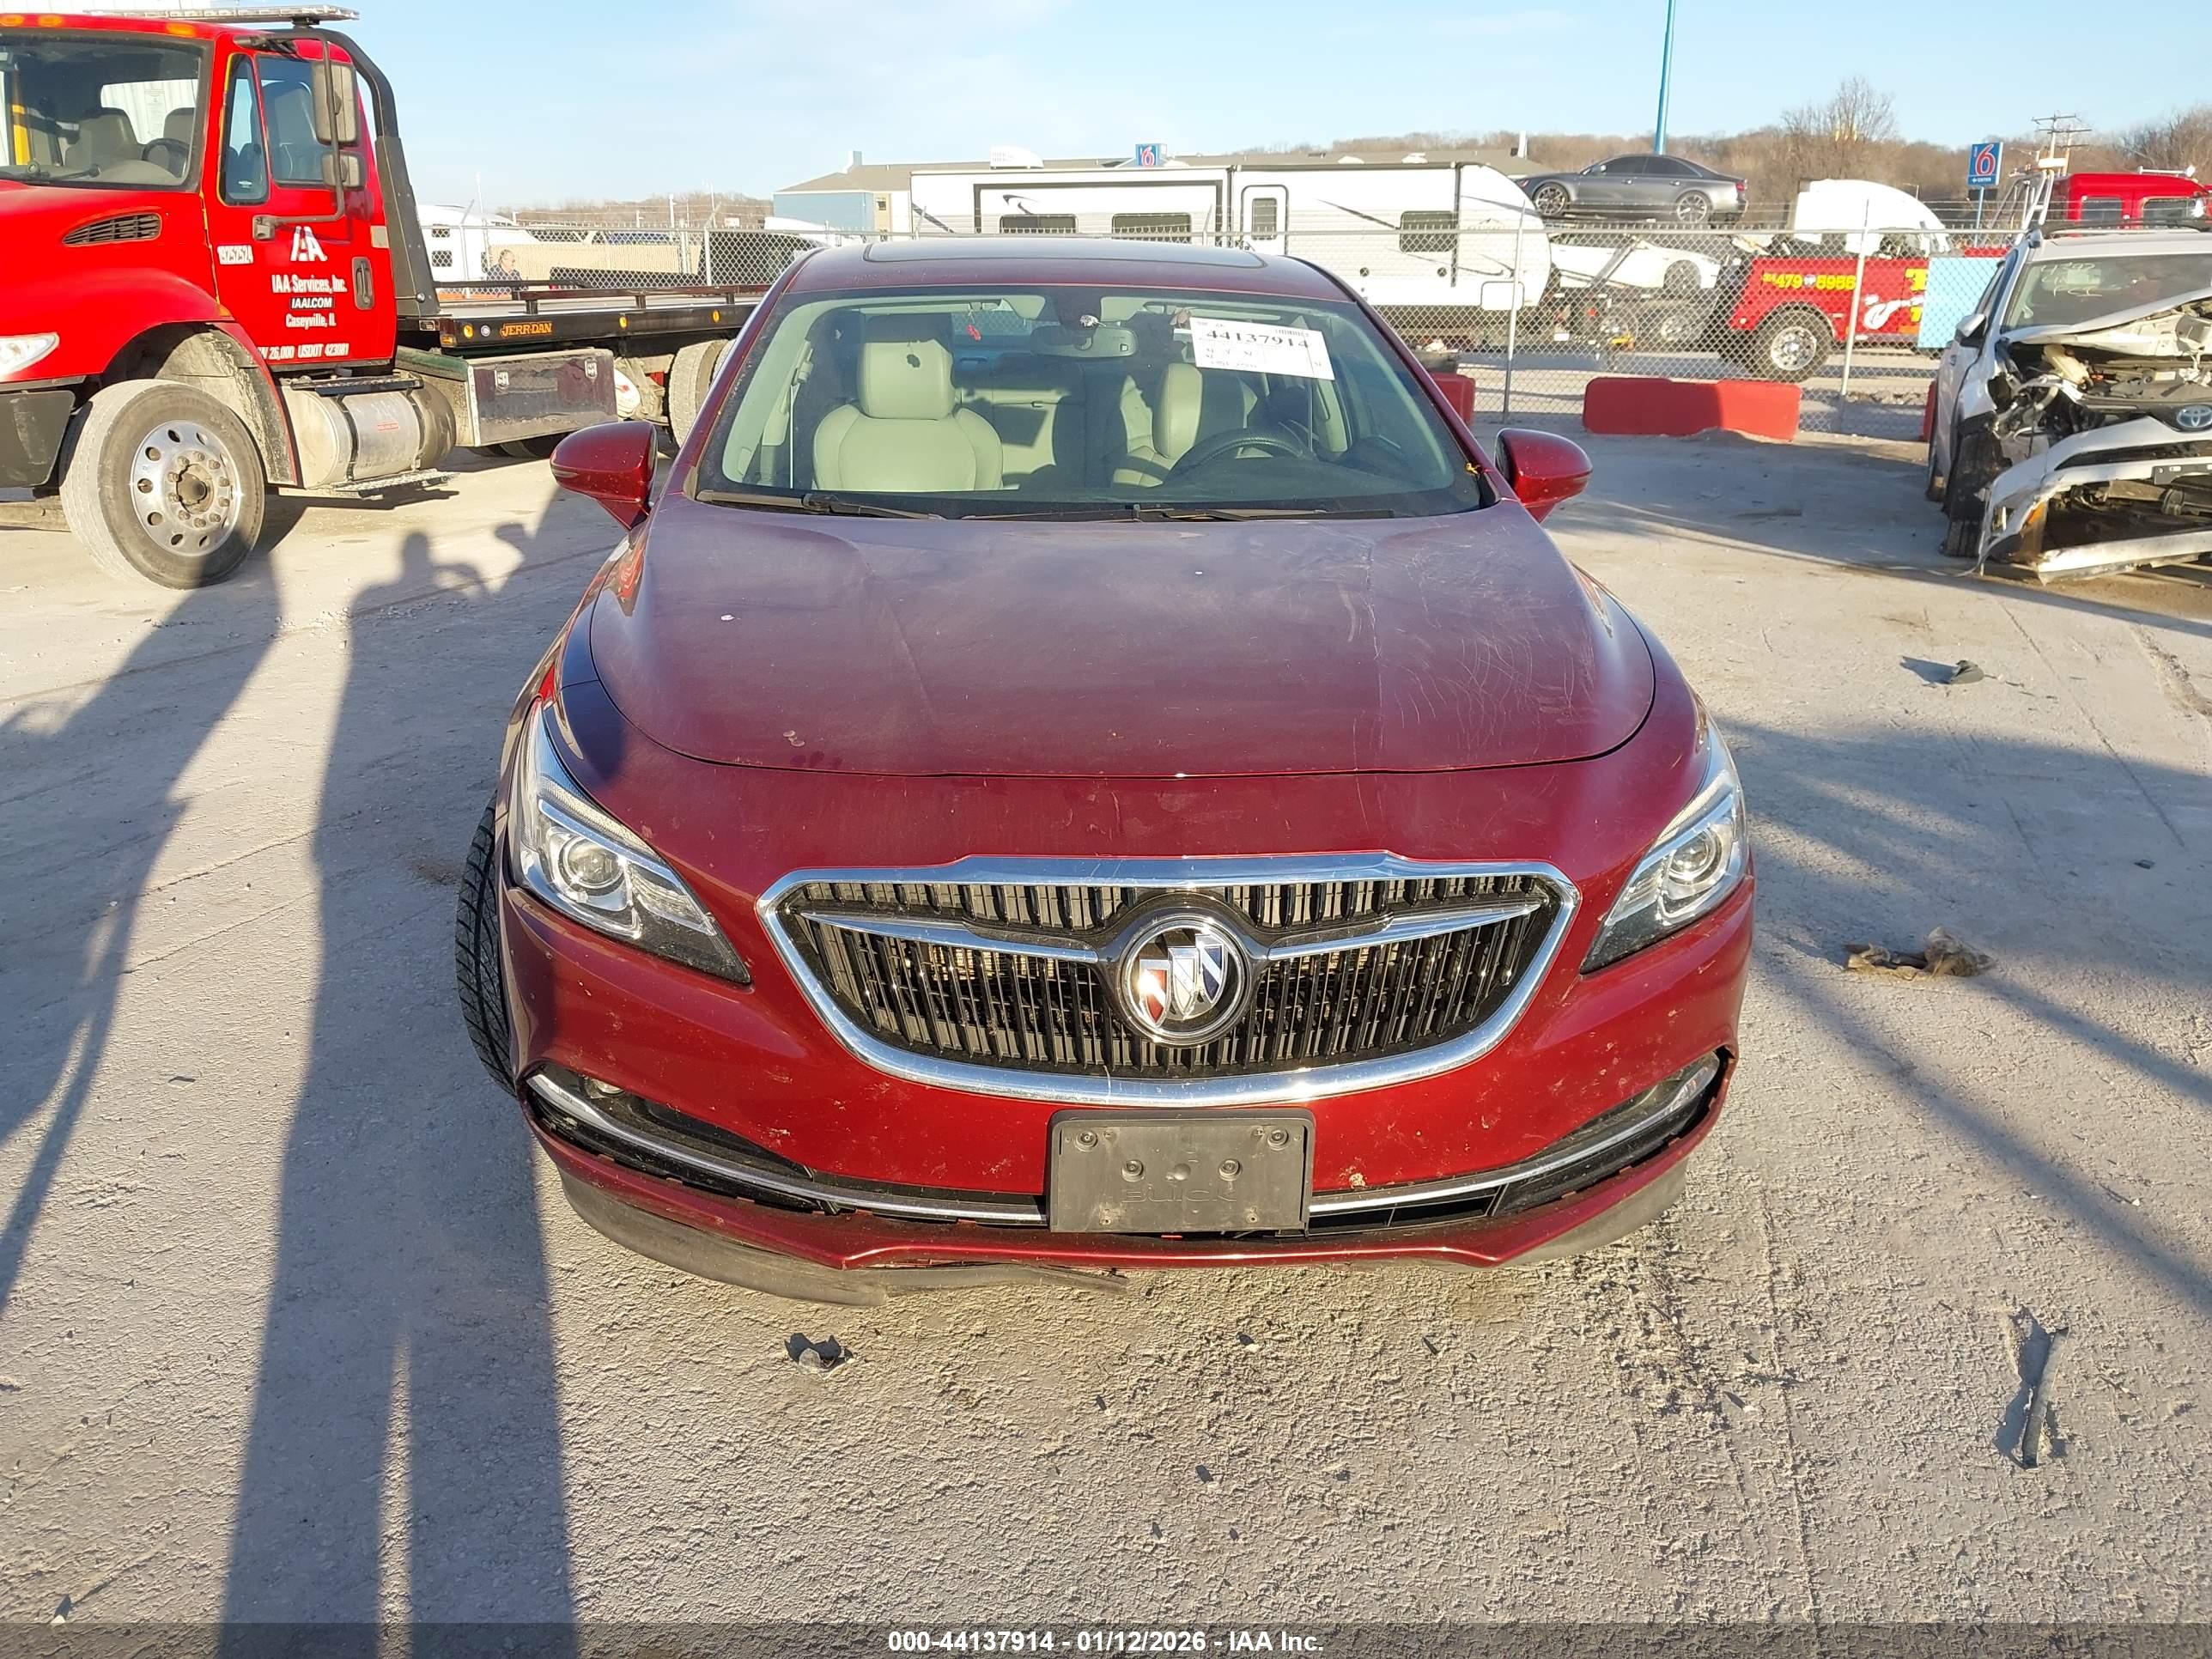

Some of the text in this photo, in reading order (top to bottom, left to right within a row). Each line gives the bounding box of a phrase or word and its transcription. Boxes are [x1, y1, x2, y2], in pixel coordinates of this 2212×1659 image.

[1141, 145, 1155, 166] 6
[1975, 144, 1996, 176] 6
[271, 274, 348, 294] IAA Services, Inc.
[292, 297, 332, 308] IAAI.COM
[1206, 331, 1308, 348] 44137914
[269, 346, 295, 360] 26,000
[298, 344, 324, 358] USDOT
